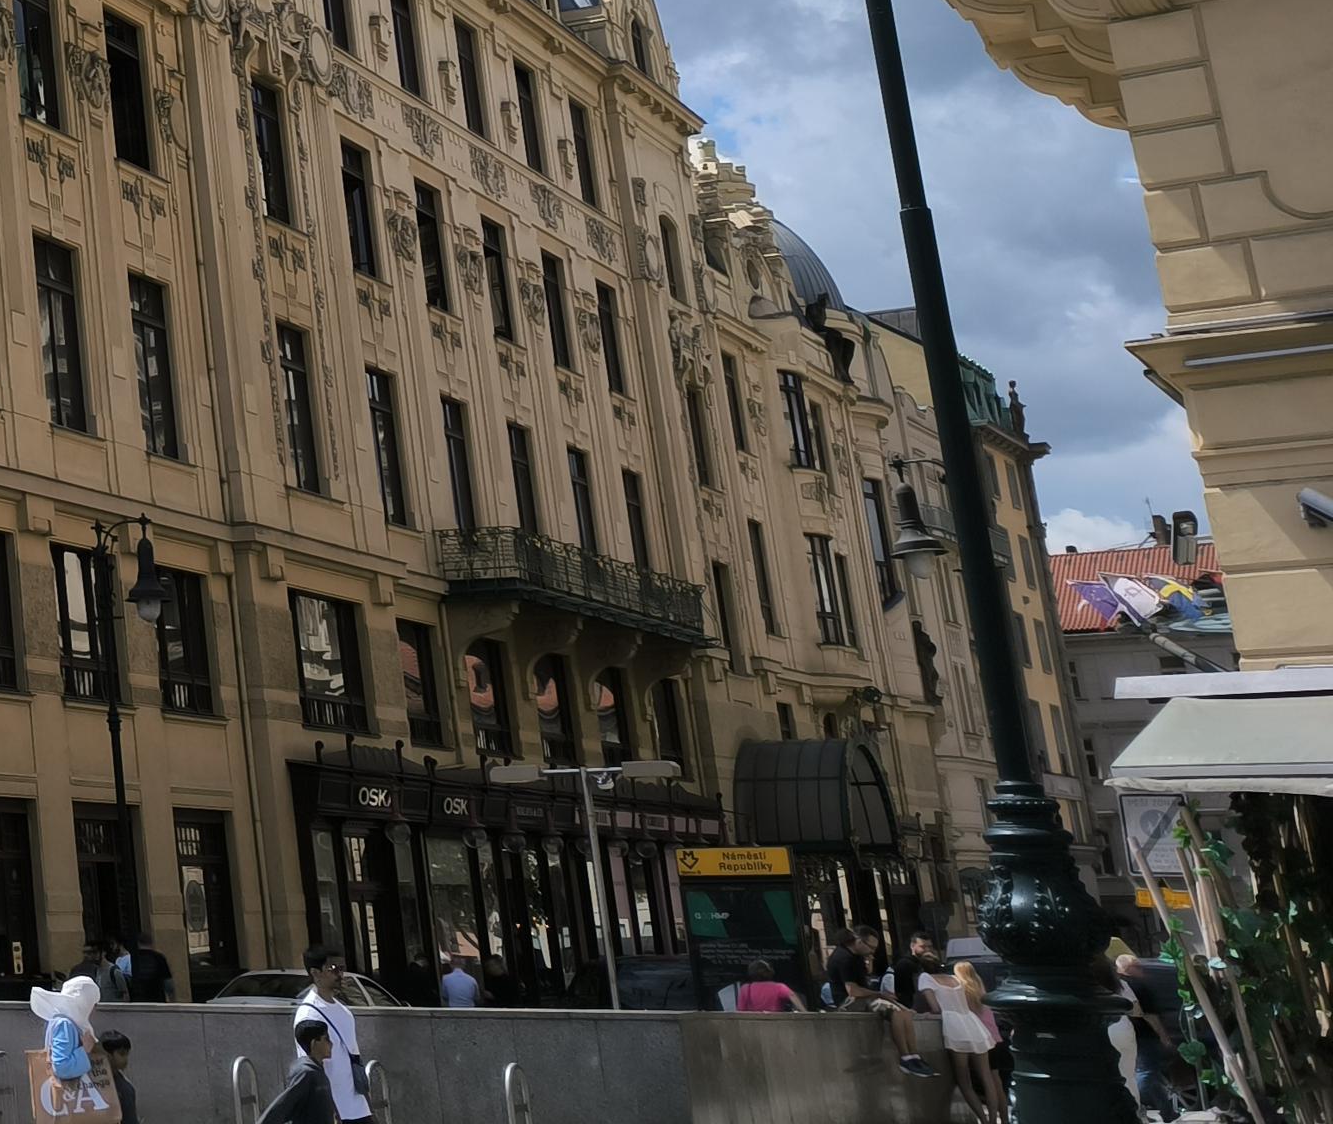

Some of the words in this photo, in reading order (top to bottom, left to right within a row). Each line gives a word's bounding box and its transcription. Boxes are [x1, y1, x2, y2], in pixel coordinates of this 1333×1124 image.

[443, 797, 470, 815] OSK
[722, 851, 766, 861] Náměstí
[718, 862, 773, 872] Republiky
[40, 1073, 110, 1117] C&A
